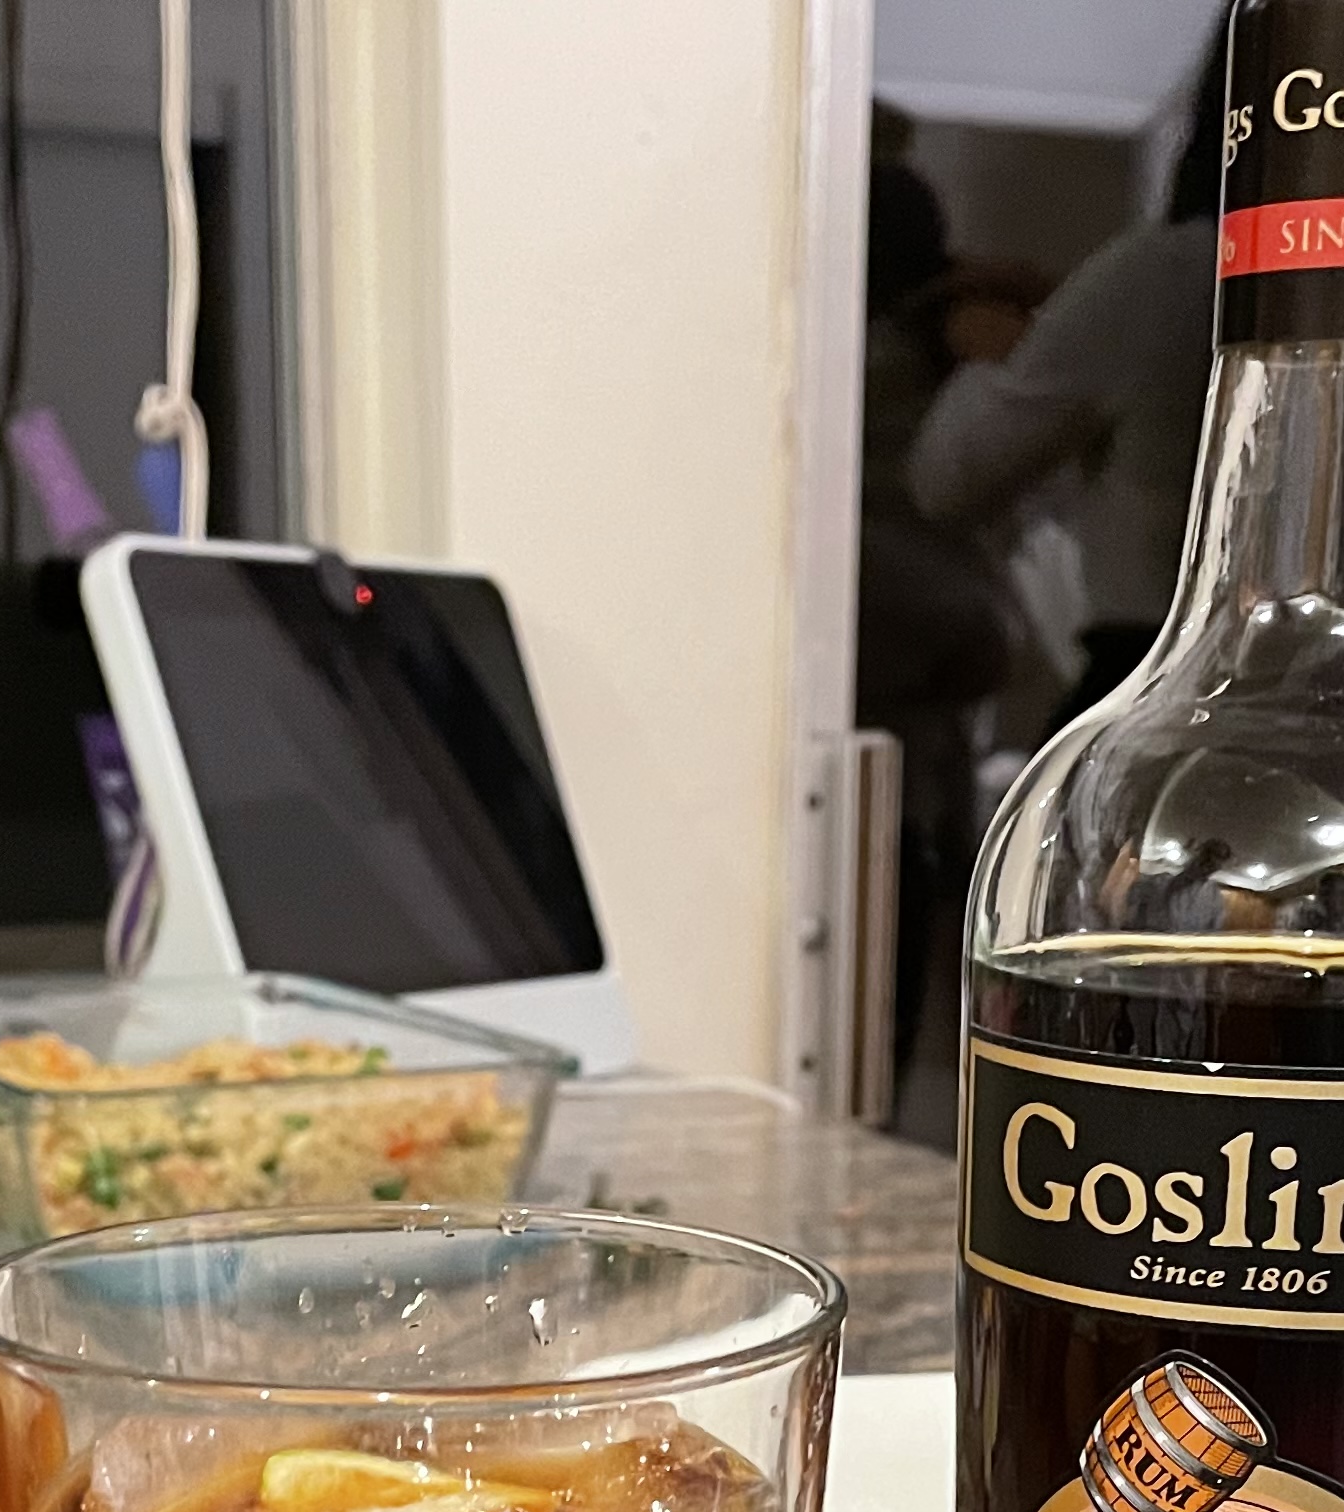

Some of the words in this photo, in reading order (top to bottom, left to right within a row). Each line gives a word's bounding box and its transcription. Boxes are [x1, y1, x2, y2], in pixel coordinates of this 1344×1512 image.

[1129, 1255, 1225, 1289] Since
[1241, 1266, 1331, 1295] 1806
[1114, 1422, 1199, 1511] RUM
